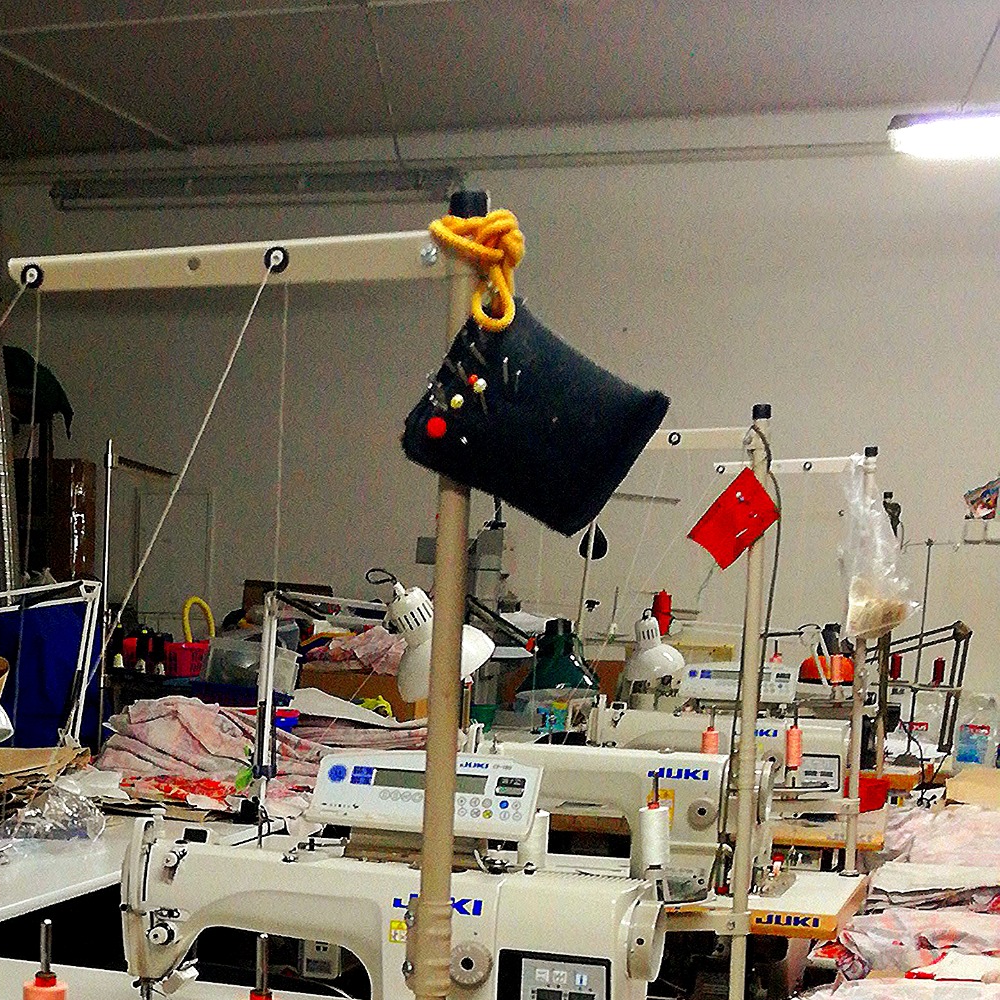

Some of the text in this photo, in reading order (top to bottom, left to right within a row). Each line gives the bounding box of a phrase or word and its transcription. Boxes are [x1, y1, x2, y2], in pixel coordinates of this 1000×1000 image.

[753, 728, 778, 738] KI
[648, 767, 709, 781] JUKI
[393, 893, 482, 916] JKI
[755, 914, 820, 928] JUKI
